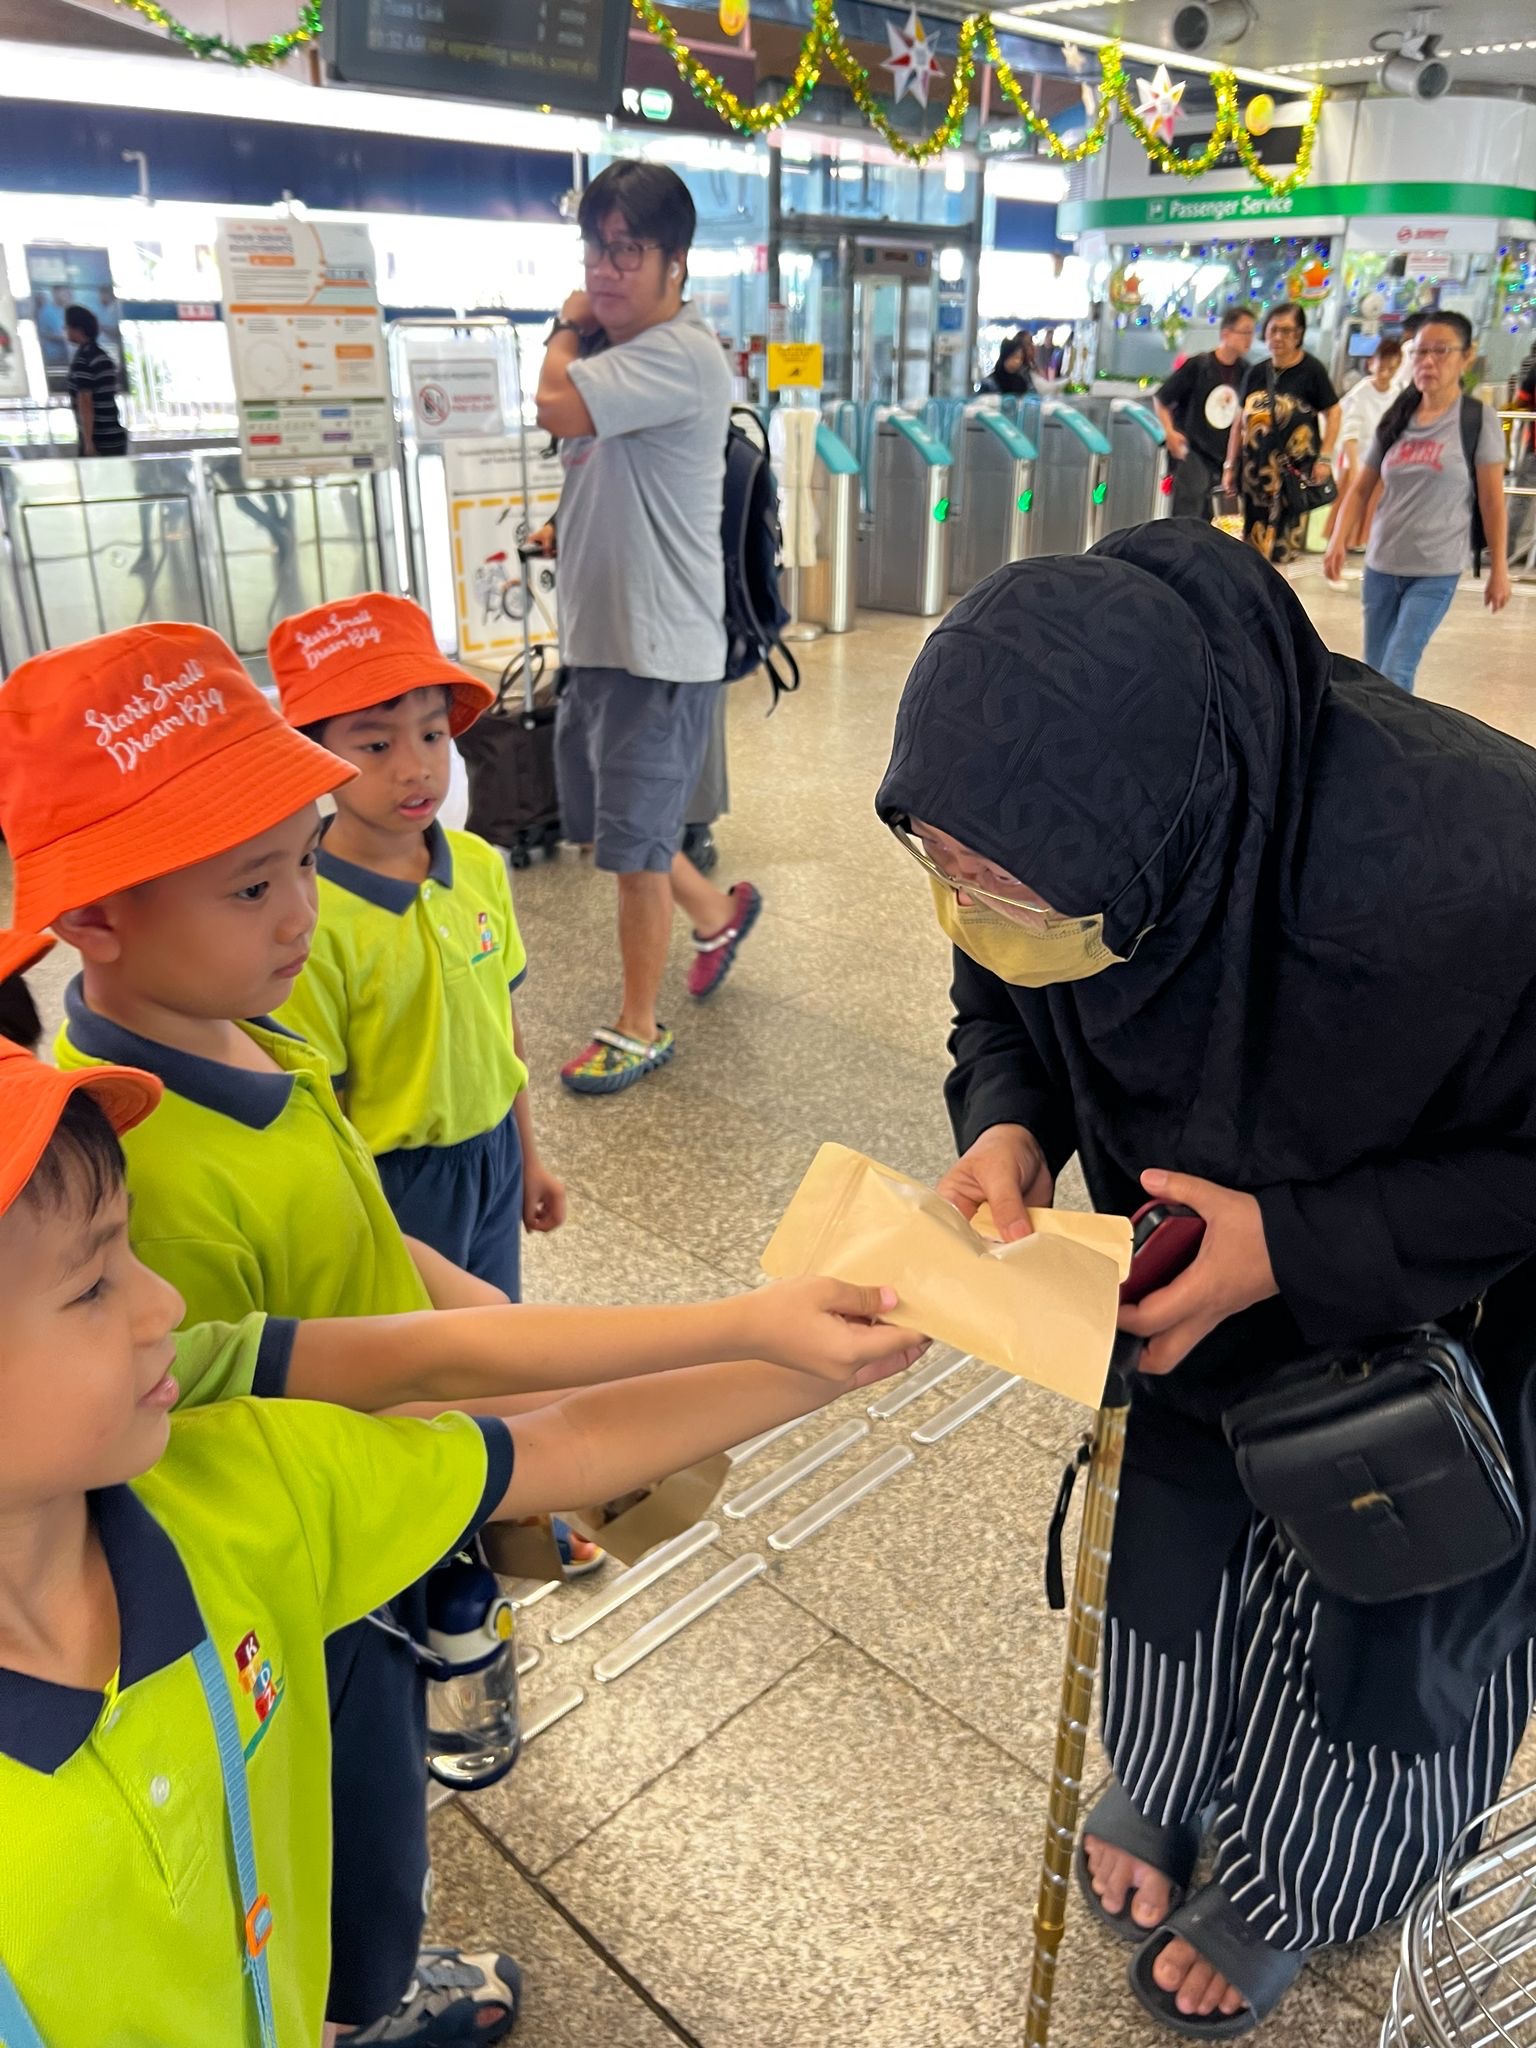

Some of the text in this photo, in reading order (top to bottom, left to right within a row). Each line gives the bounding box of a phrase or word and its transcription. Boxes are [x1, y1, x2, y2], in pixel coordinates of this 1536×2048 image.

[1169, 195, 1293, 220] Passenger Service
[295, 609, 372, 655] Start Small
[305, 625, 381, 670] Dream Big
[84, 658, 205, 747] Start Small
[106, 687, 226, 775] Dream Big
